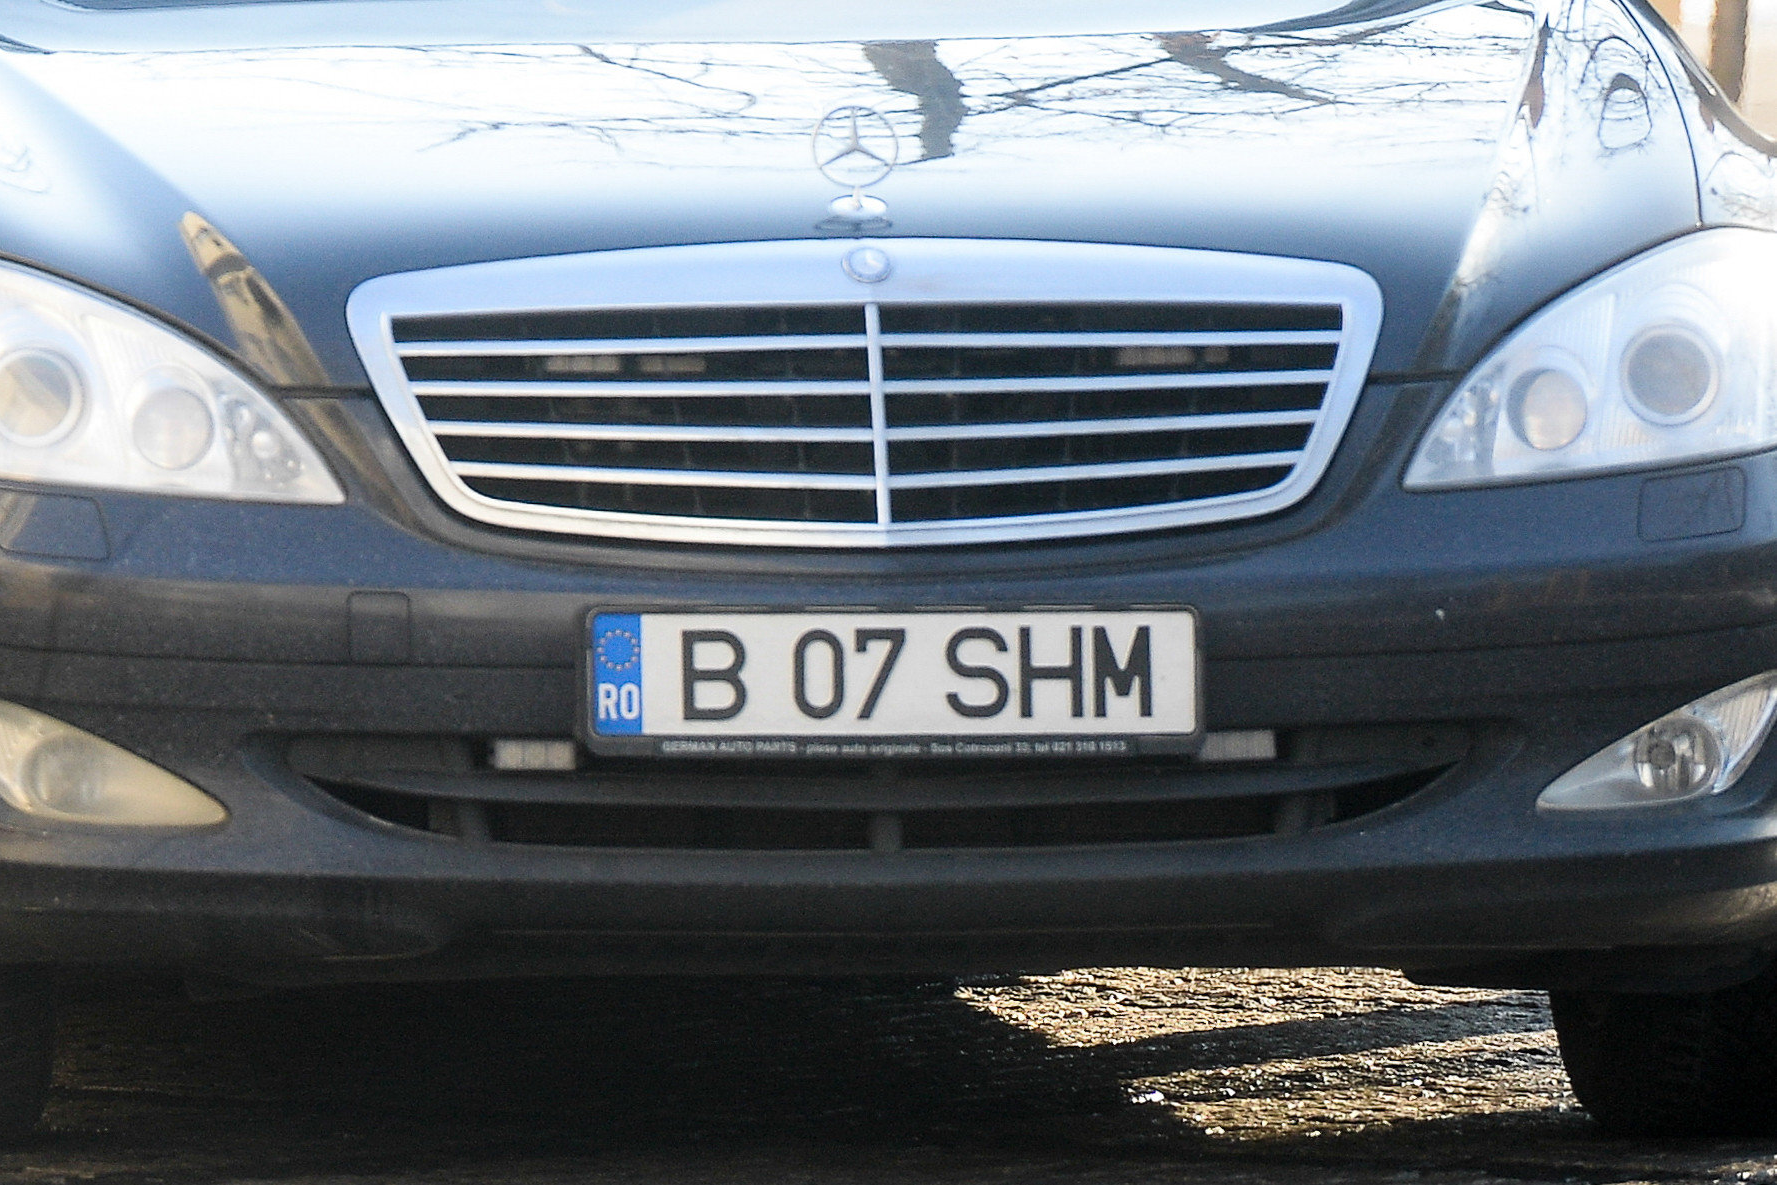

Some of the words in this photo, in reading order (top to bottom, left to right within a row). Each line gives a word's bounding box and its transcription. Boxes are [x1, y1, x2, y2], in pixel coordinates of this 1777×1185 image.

[681, 629, 746, 720] B
[793, 628, 906, 719] 07
[944, 625, 1153, 719] SHM
[597, 682, 641, 720] RO
[719, 741, 754, 752] AUTO
[755, 741, 796, 752] PARTS
